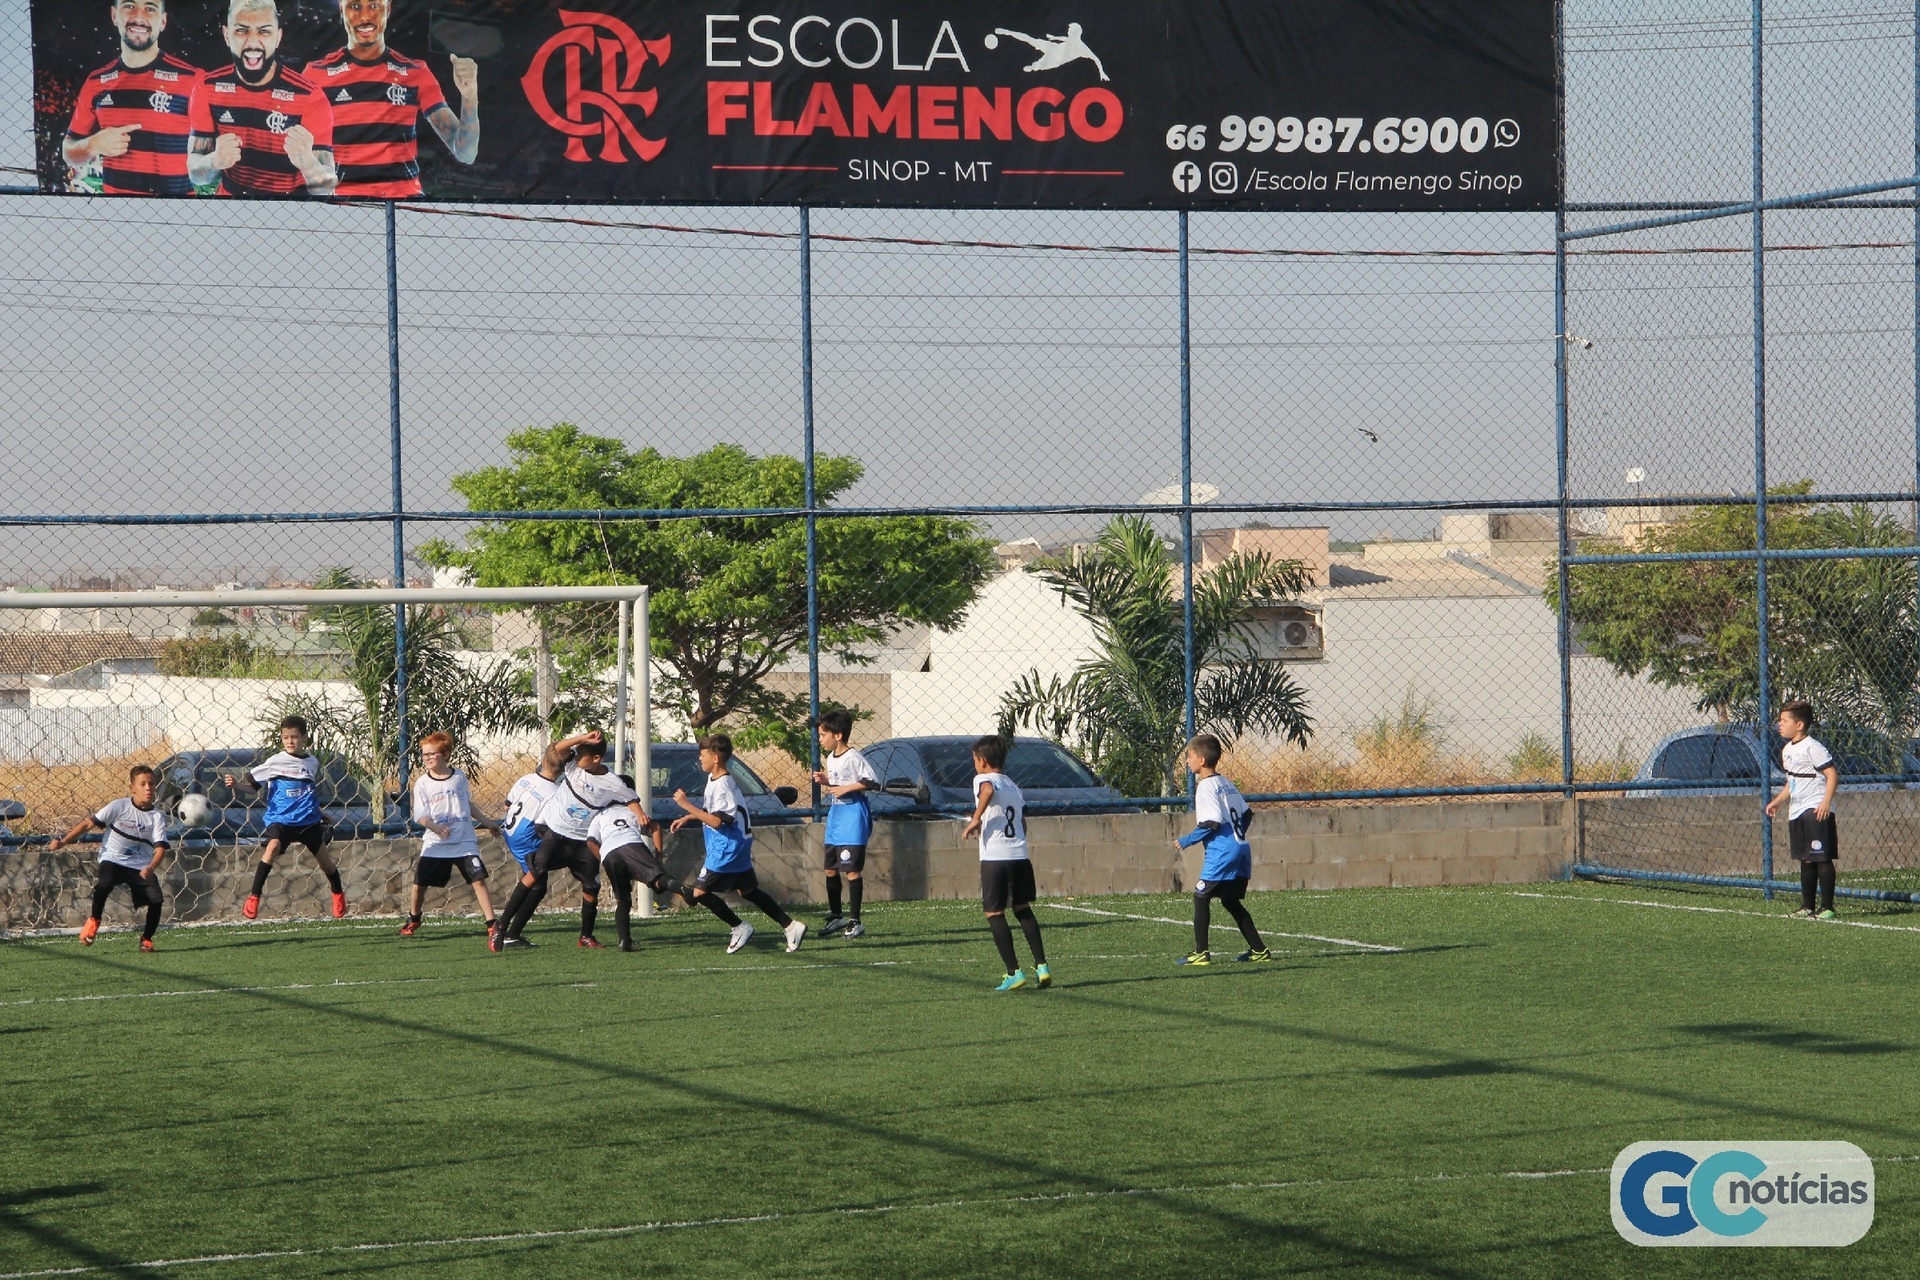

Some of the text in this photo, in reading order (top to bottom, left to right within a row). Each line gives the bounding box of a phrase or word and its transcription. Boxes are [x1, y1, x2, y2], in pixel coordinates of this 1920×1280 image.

[705, 14, 971, 73] ESCOLA
[707, 80, 1124, 143] FLAMENGO
[1165, 114, 1489, 154] 66 99987.6900
[848, 158, 930, 182] SINOP
[954, 161, 993, 182] MT
[1335, 170, 1453, 195] Flamengo
[1458, 169, 1523, 195] Sinop
[1004, 805, 1016, 838] 8
[1229, 807, 1246, 841] 8
